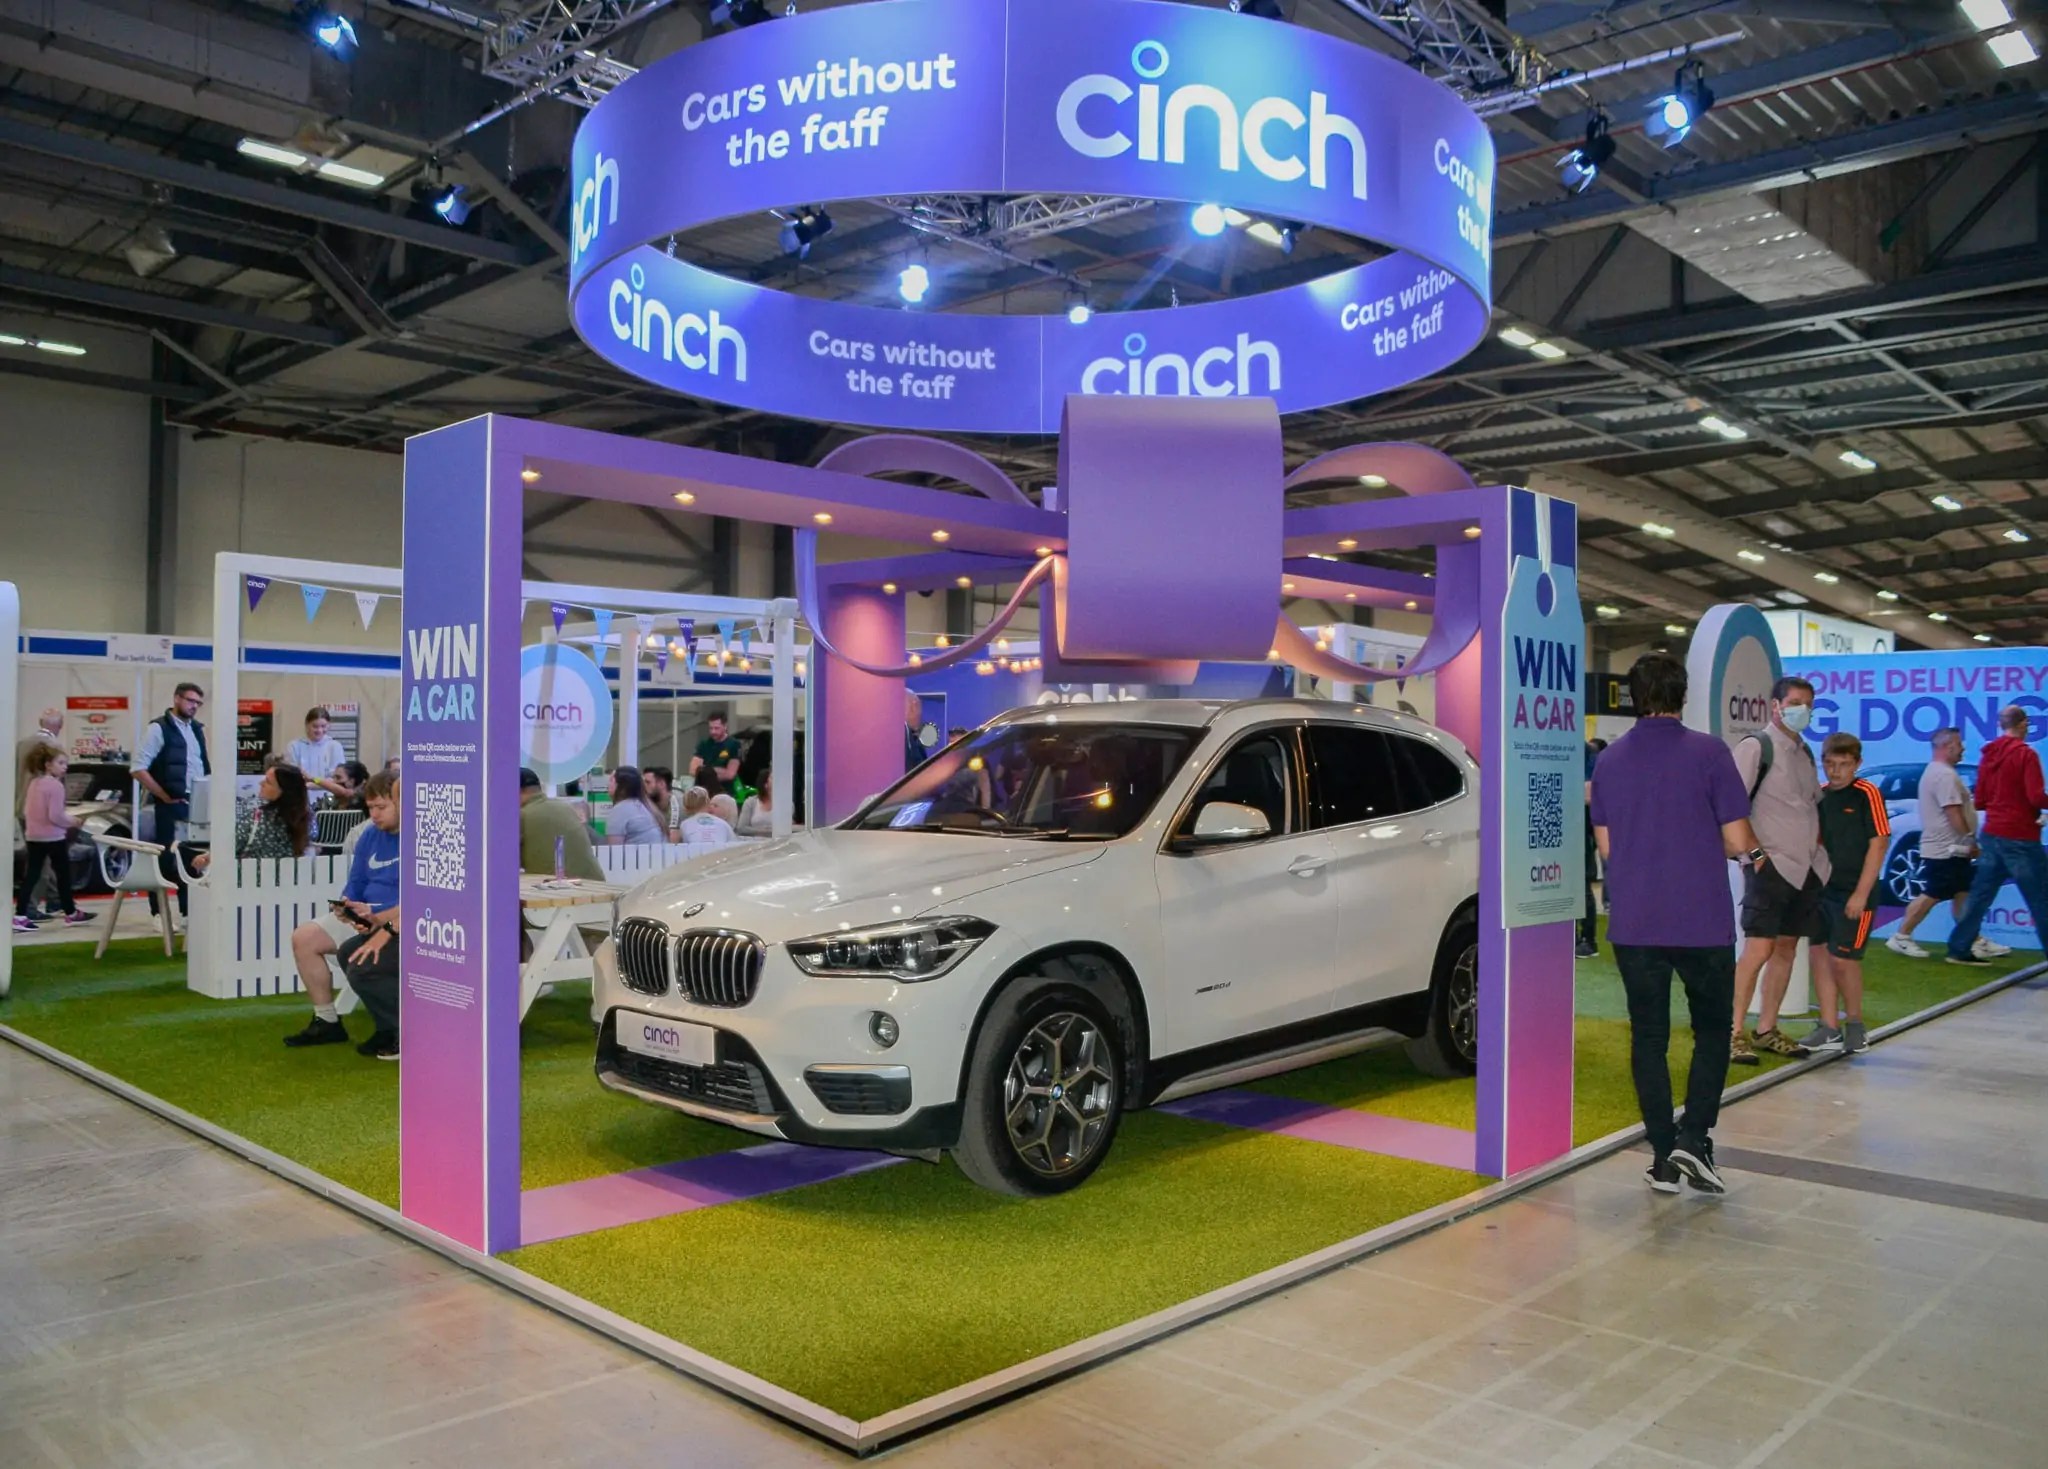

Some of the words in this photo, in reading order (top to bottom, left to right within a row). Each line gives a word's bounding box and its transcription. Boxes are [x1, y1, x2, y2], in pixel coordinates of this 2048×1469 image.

[682, 84, 767, 131] Cars
[777, 53, 957, 106] without
[726, 127, 791, 167] the
[801, 105, 889, 154] faff
[1056, 40, 1367, 200] cinch
[1434, 138, 1475, 198] Cars
[609, 262, 747, 382] cinch
[1341, 302, 1395, 331] Cars
[1373, 327, 1408, 356] the
[1411, 300, 1445, 344] faff
[809, 330, 876, 362] Cars
[883, 341, 996, 370] without
[1081, 332, 1281, 397] cinch
[846, 369, 893, 395] the
[901, 373, 956, 400] faff
[247, 580, 267, 588] cinch
[552, 607, 567, 615] cinch
[409, 623, 478, 680] WIN
[1513, 634, 1576, 693] WIN
[1783, 670, 1875, 696] OME
[1885, 666, 2048, 693] DELIVERY
[406, 686, 424, 721] A
[427, 683, 476, 722] CAR
[523, 701, 582, 722] cinch
[1513, 693, 1529, 729] A
[1533, 694, 1576, 732] CAR
[1729, 687, 1768, 723] cinch
[75, 738, 118, 746] STNT
[1530, 861, 1562, 883] cinch
[416, 908, 466, 951] cinch
[1987, 908, 2036, 927] inc
[643, 1025, 680, 1047] cinch
